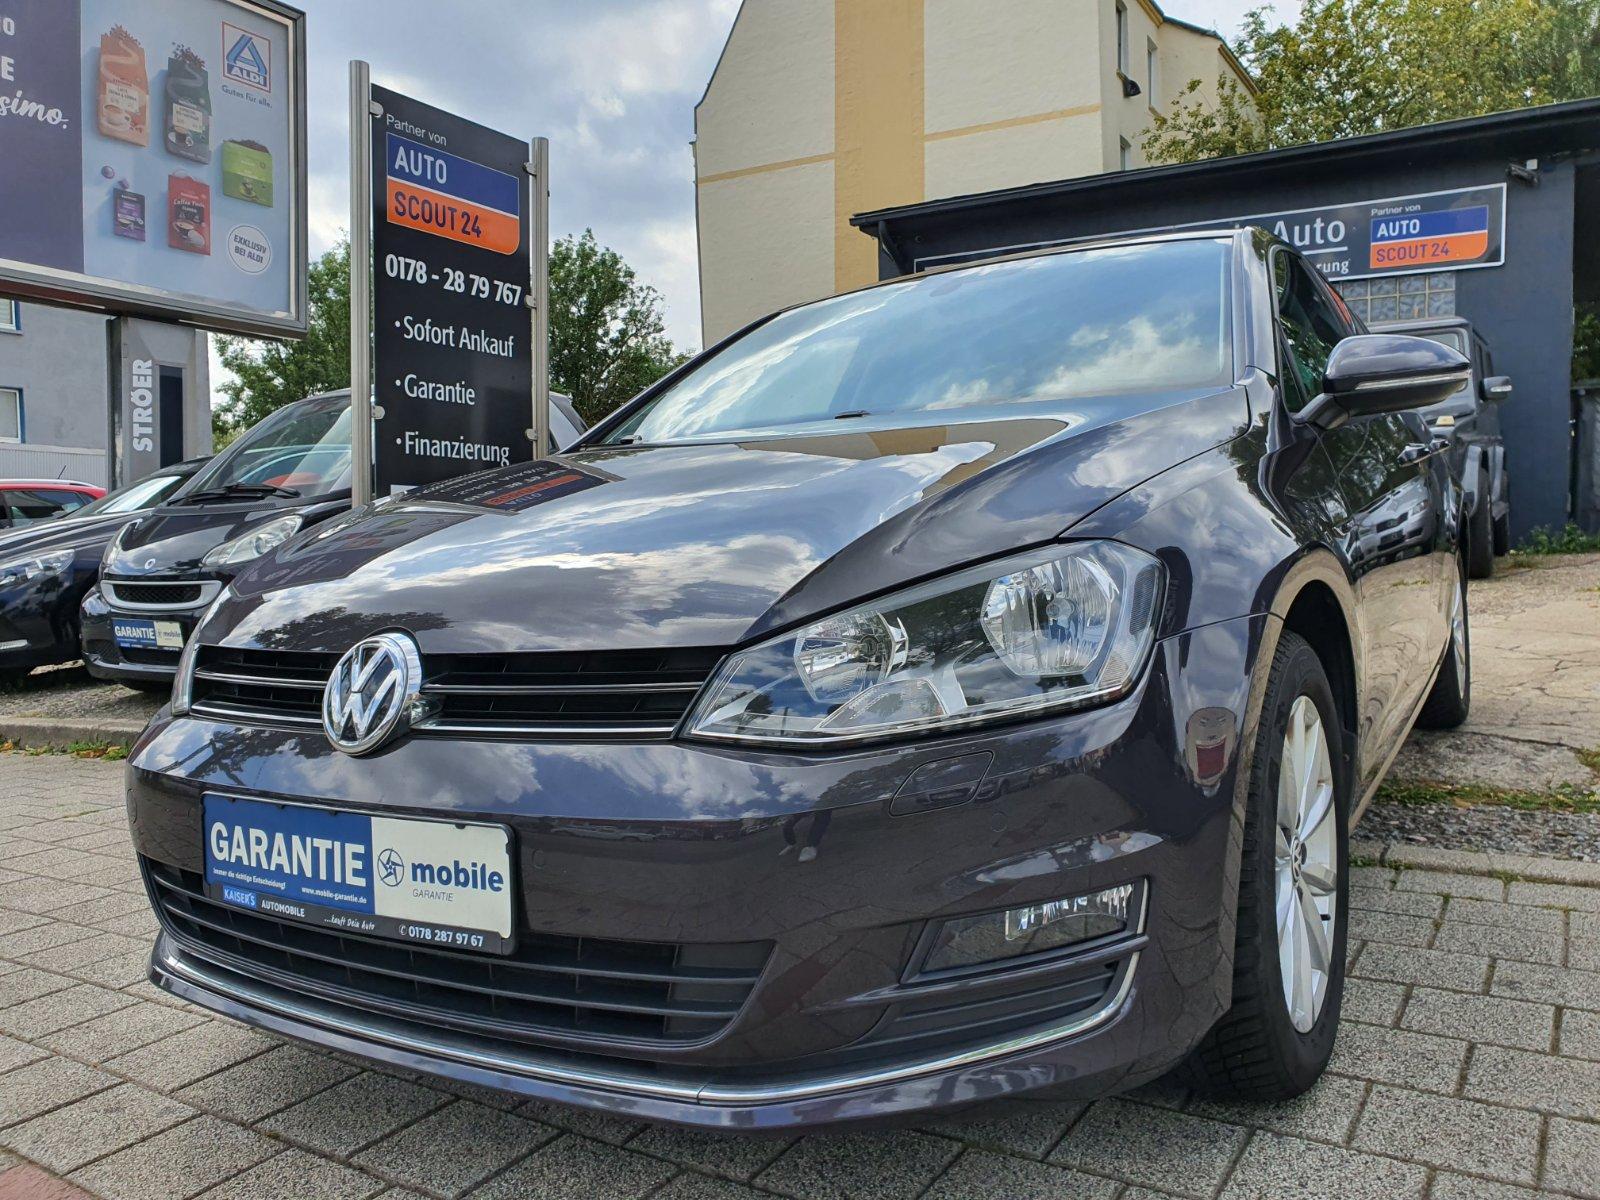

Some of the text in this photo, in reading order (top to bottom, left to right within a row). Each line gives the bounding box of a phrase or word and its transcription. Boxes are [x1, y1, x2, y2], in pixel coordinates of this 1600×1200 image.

[222, 84, 244, 98] Gutes
[386, 114, 447, 147] Partner von
[394, 145, 447, 185] AUTO
[394, 191, 481, 238] SCOUT 24
[1371, 204, 1421, 216] Partner von
[1274, 217, 1346, 247] Auto
[1377, 219, 1420, 238] AUTO
[233, 234, 267, 254] EXKLUSIV
[234, 245, 264, 263] BEI ALDI
[1376, 241, 1450, 262] SCOUT 24
[385, 253, 428, 285] 0178
[443, 267, 465, 293] 28
[469, 273, 490, 299] 79
[493, 279, 522, 306] 767
[403, 315, 514, 358] Sofort Ankauf
[404, 373, 475, 405] Garantie
[130, 359, 153, 452] STRÖER
[405, 431, 510, 467] Finanzierung
[114, 625, 155, 639] GARANTIE
[210, 821, 366, 887] GARANTIE
[411, 859, 504, 892] mobile
[302, 887, 367, 904] www.mobile-garantie.de
[412, 888, 453, 902] GARANTIE
[261, 899, 305, 917] AUTOMOBILE
[408, 927, 484, 947] 0178 287 97 67
